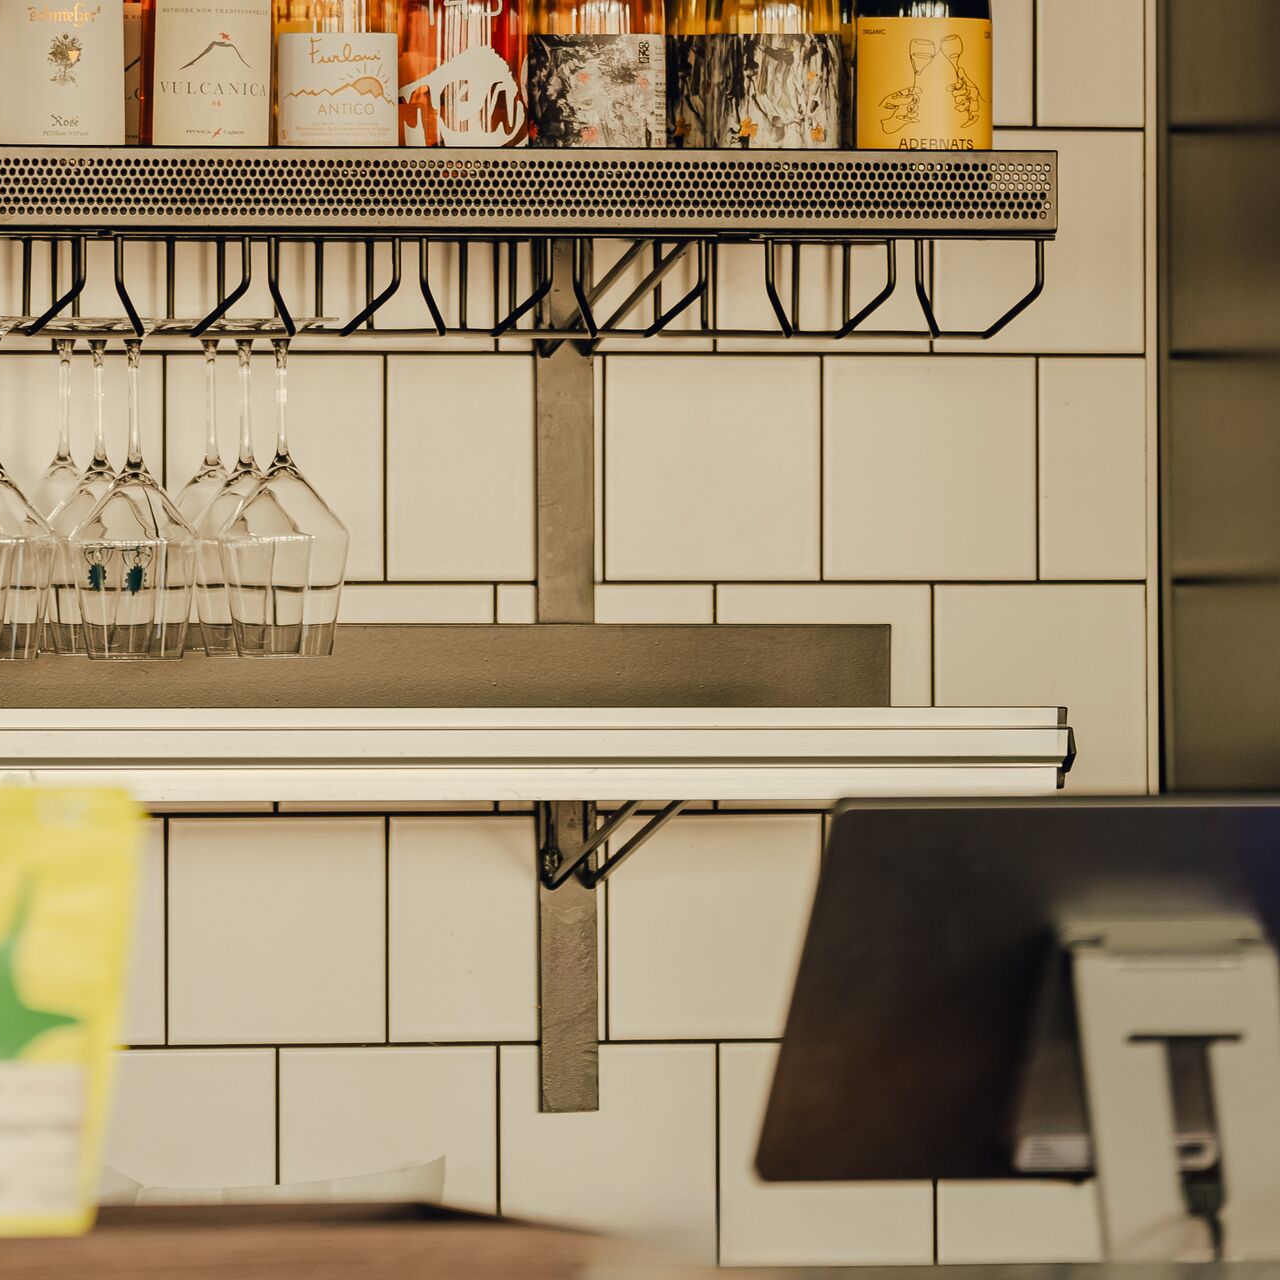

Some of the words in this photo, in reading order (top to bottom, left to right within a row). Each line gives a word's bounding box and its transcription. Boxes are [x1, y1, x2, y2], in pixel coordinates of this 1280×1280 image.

[309, 37, 381, 64] Furlani
[160, 81, 267, 97] VULCANICA
[318, 103, 375, 116] ANTICO
[51, 115, 79, 127] Rosé
[899, 138, 974, 150] ADERNATS
